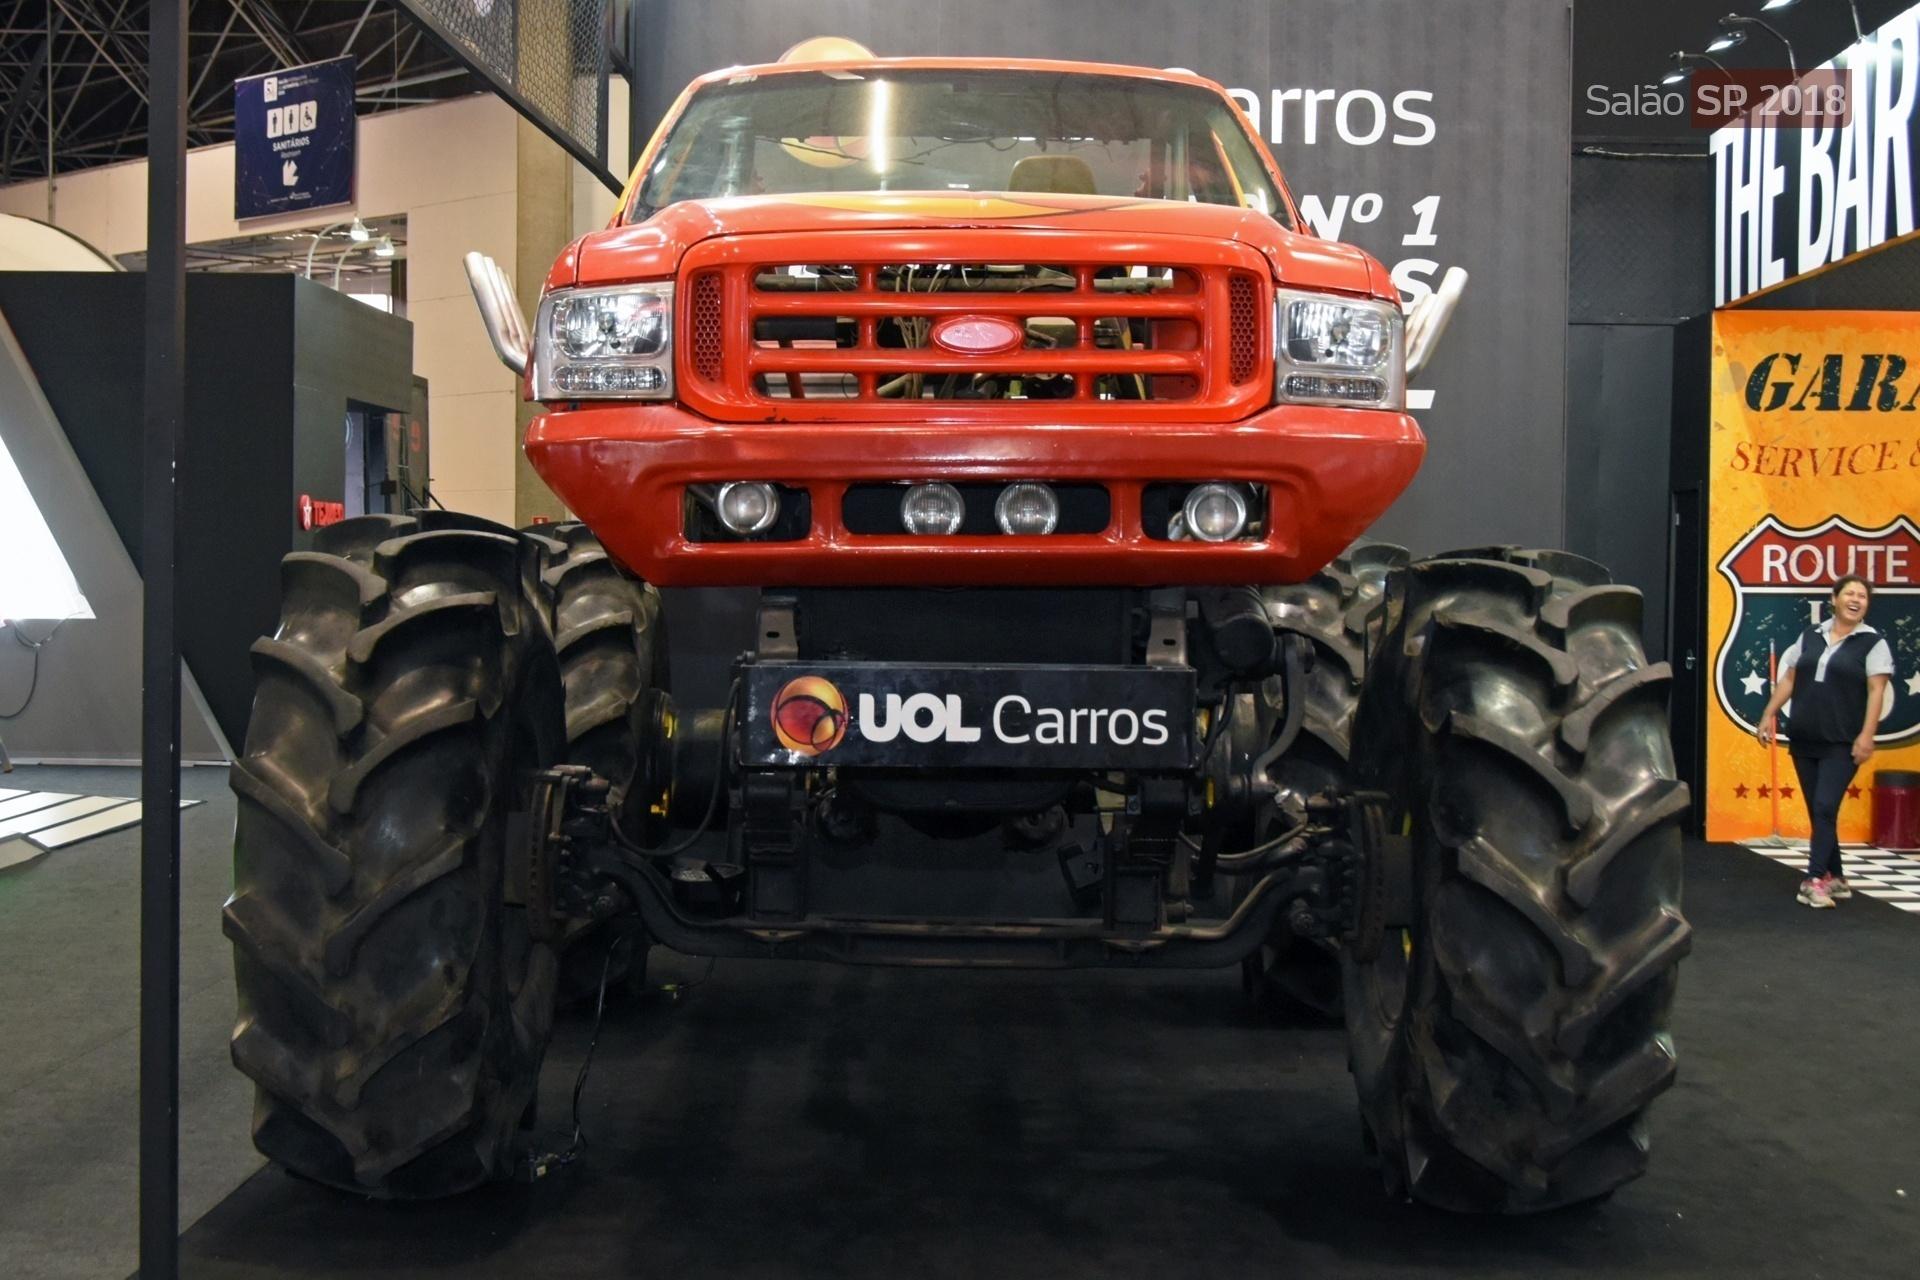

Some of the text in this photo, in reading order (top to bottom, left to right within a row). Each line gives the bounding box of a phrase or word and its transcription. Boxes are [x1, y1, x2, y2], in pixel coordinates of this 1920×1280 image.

[272, 136, 311, 151] SANITÁRIOS
[1709, 3, 1919, 309] THE BAR
[1744, 352, 1920, 413] GAR
[1730, 439, 1901, 478] SERVICE
[1763, 544, 1909, 584] ROUTE
[858, 692, 1169, 746] UOL Carros
